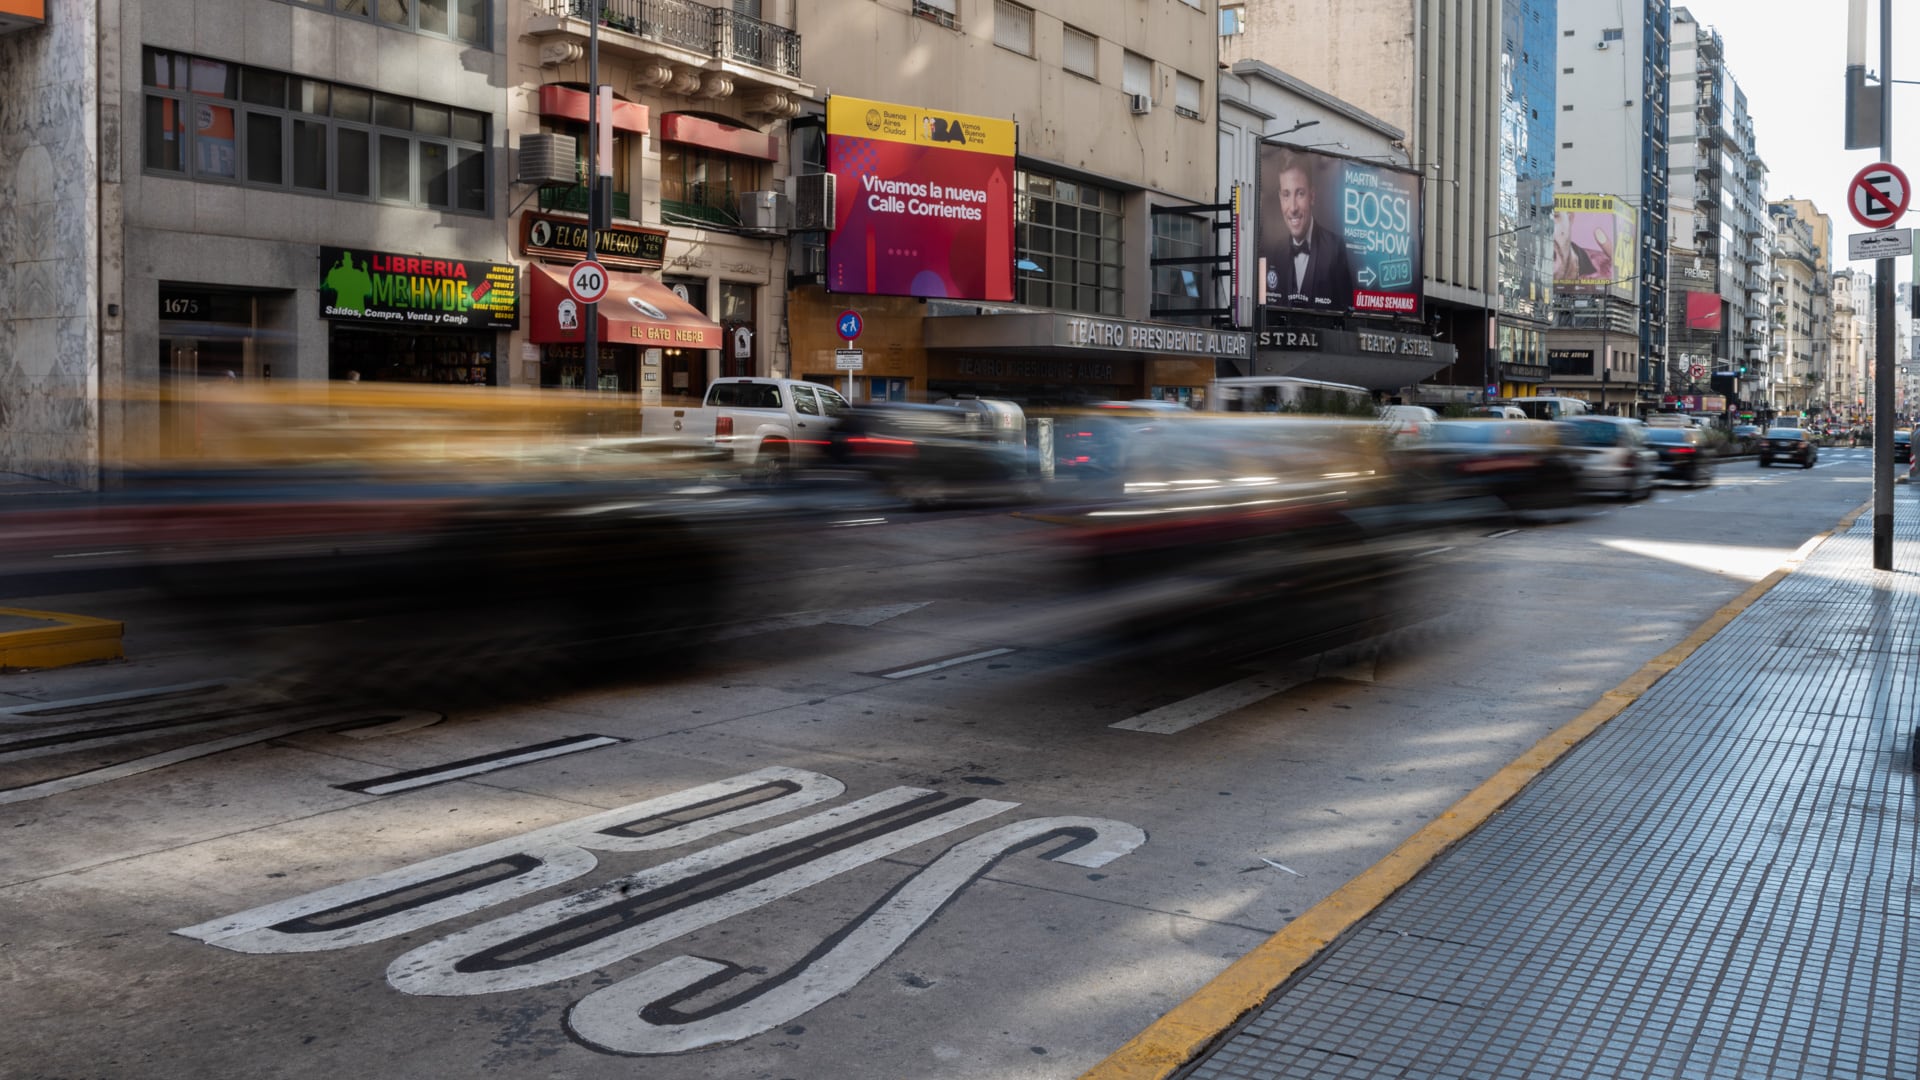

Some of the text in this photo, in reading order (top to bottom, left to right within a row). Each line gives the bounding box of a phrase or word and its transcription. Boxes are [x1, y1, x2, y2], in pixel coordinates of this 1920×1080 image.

[883, 110, 907, 121] Buenos
[883, 118, 901, 127] Aires
[883, 126, 907, 136] Ciudad
[961, 121, 981, 131] Vamos
[964, 128, 986, 138] Buenos
[968, 135, 984, 144] Aires
[862, 174, 987, 203] Vivamos la nueva
[867, 195, 982, 221] Calle Corrientes
[1344, 188, 1411, 234] BOSSI
[1584, 198, 1600, 210] QUE
[1602, 199, 1613, 210] NO
[572, 227, 599, 249] GAO
[601, 231, 640, 254] NEGRO
[1366, 230, 1410, 257] SHOW
[372, 254, 468, 279] LIBRERIA
[1382, 263, 1408, 282] 2019
[576, 273, 601, 291] 40
[410, 276, 468, 312] HYDE
[1356, 292, 1414, 310] ÚLTIMAS SEMANAS
[164, 298, 199, 314] 1675
[325, 305, 468, 324] Saldos, Compra, Venta y Canje
[631, 326, 704, 344] EL GATO NEGRO
[1069, 320, 1247, 355] TEATRO PRESIDENTE ALVEAR
[1255, 332, 1319, 347] STRAL
[1359, 332, 1434, 357] TEATRO ASTRAL
[172, 765, 1149, 1056] BUS
